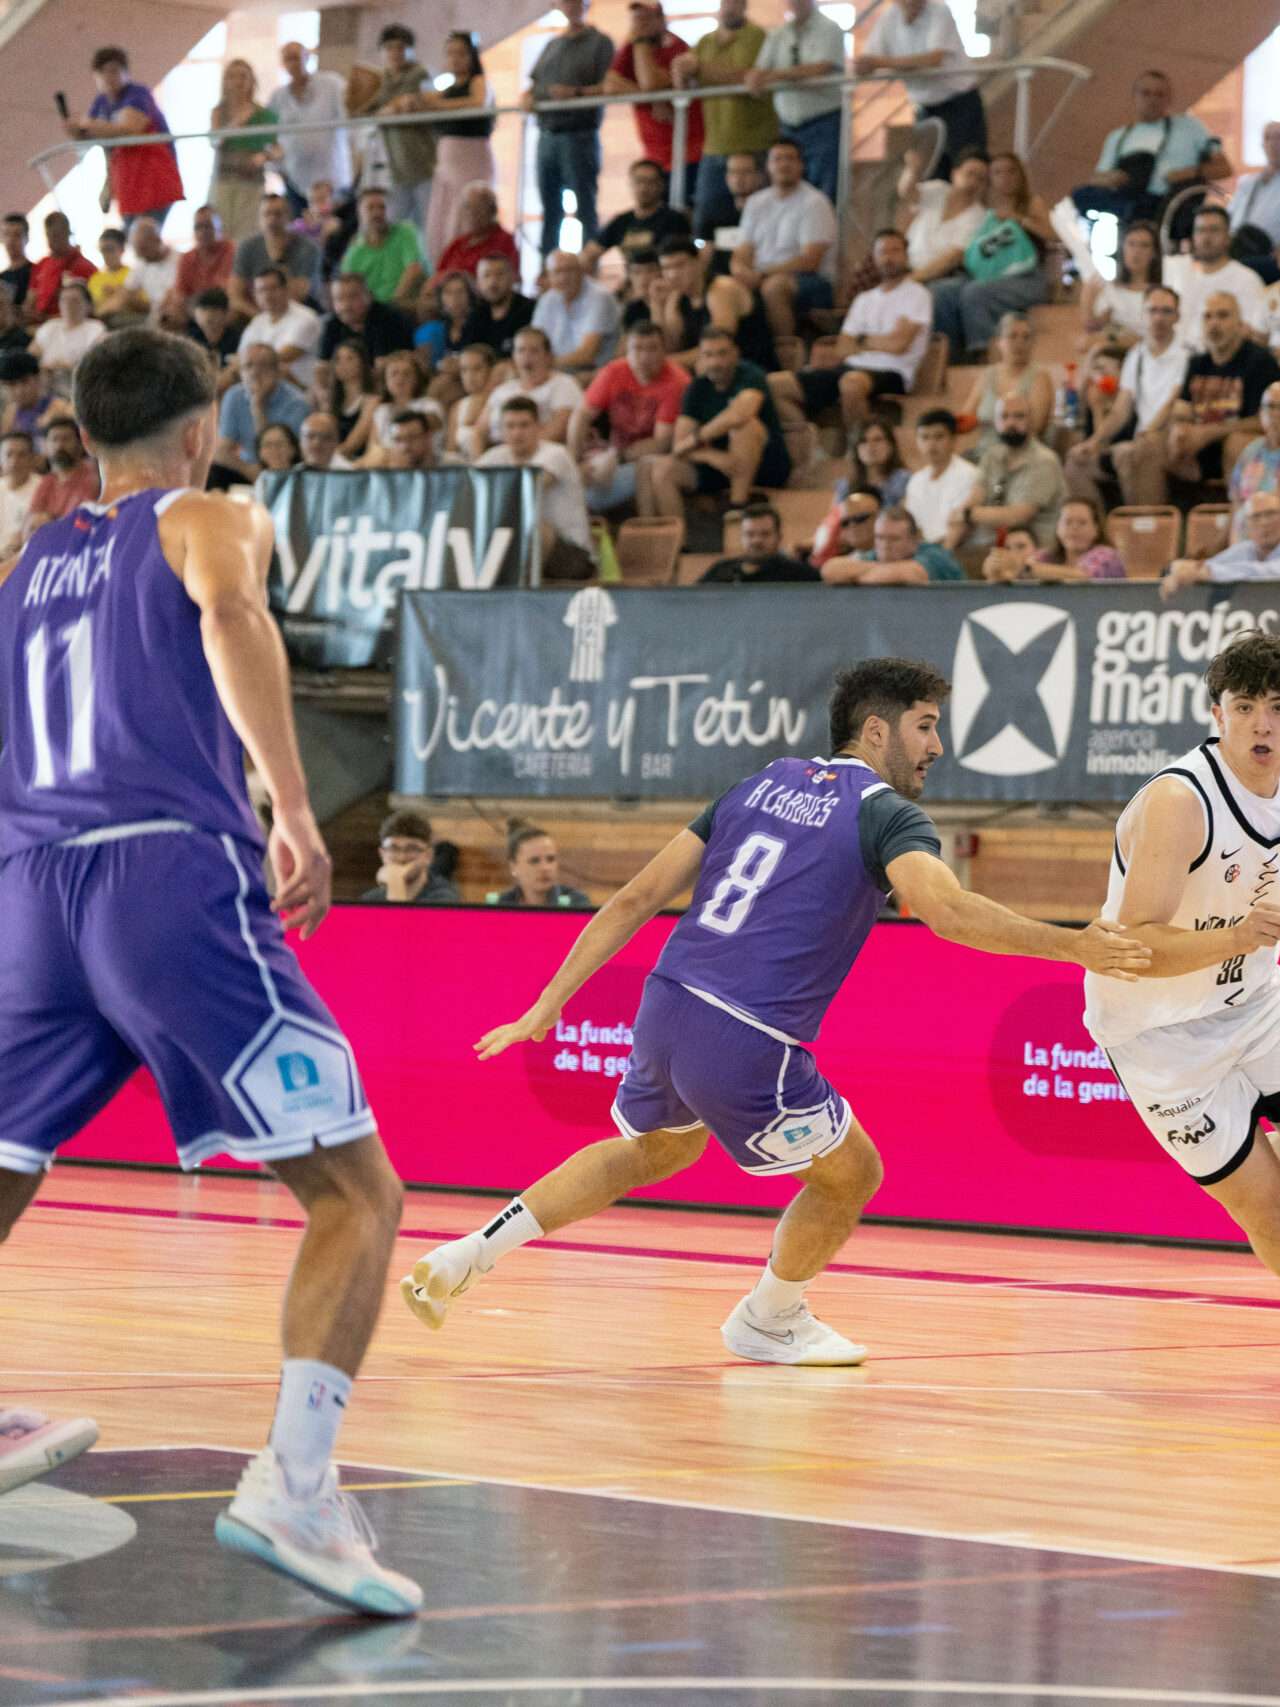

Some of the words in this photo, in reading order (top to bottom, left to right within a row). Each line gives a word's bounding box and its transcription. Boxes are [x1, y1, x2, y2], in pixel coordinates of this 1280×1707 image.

[25, 612, 95, 789] 11
[403, 664, 596, 763] Vicente
[607, 697, 637, 776] y
[629, 673, 808, 749] Tetín
[697, 831, 787, 936] 8
[1215, 953, 1247, 986] 32
[556, 1020, 578, 1042] La
[579, 1019, 634, 1046] funda
[554, 1049, 579, 1071] de
[582, 1050, 600, 1072] la
[1024, 1041, 1049, 1066] La
[1023, 1073, 1049, 1097] de
[1054, 1074, 1073, 1099] la
[1156, 1097, 1201, 1118] aqualia
